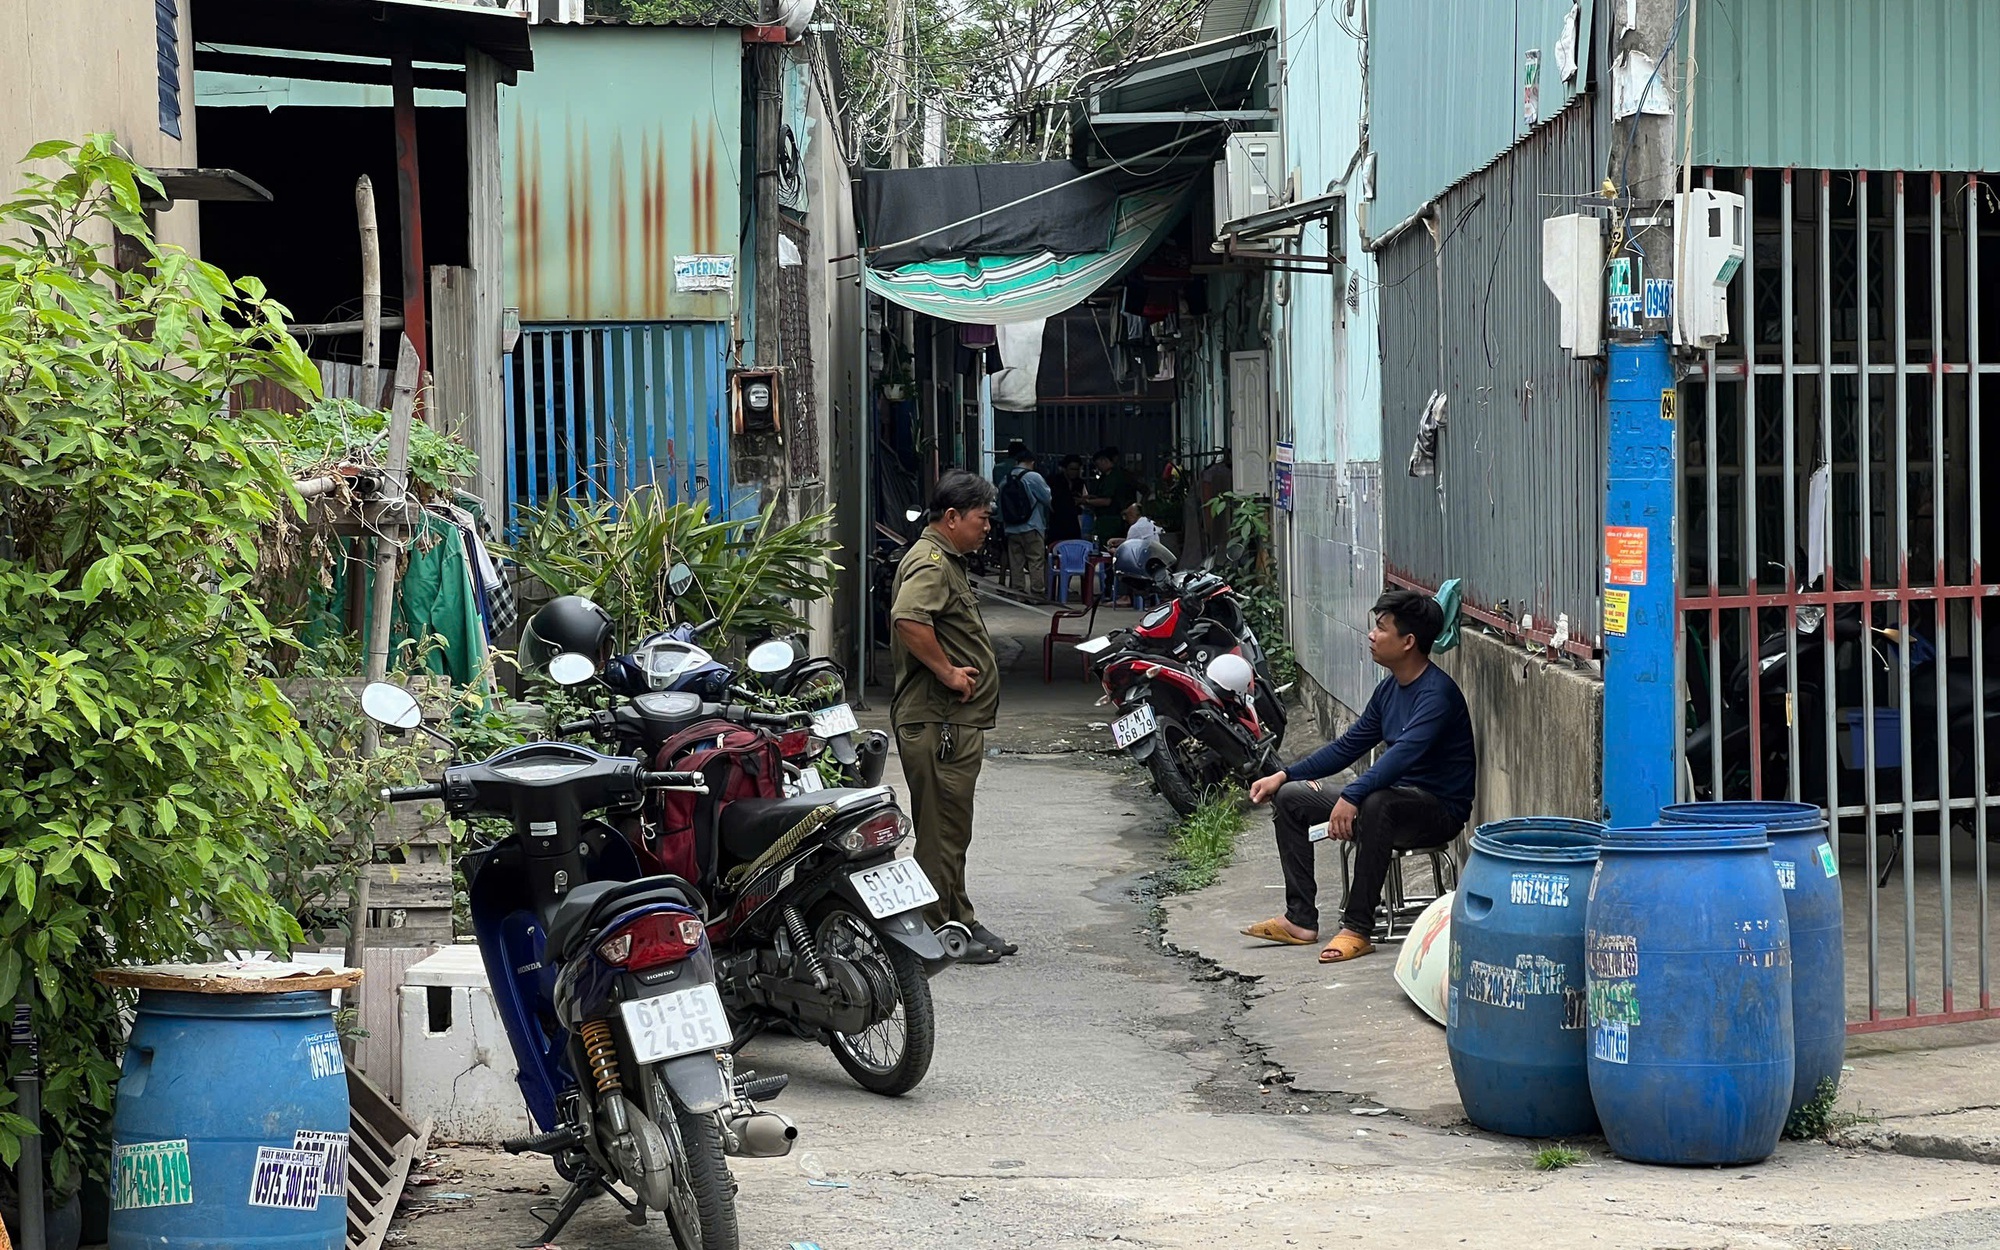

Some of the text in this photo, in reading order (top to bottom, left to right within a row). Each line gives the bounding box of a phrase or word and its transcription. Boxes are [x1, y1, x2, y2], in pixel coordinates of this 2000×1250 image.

[1118, 709, 1146, 733] 67-N1
[1118, 718, 1153, 746] 268.79
[863, 863, 914, 892] 61-D1
[869, 883, 932, 914] 354.24
[517, 961, 542, 975] HONDA
[646, 969, 675, 981] HONDA
[635, 989, 709, 1028] 61-L5
[644, 1022, 717, 1056] 2495
[255, 1162, 320, 1208] 0975.300.655
